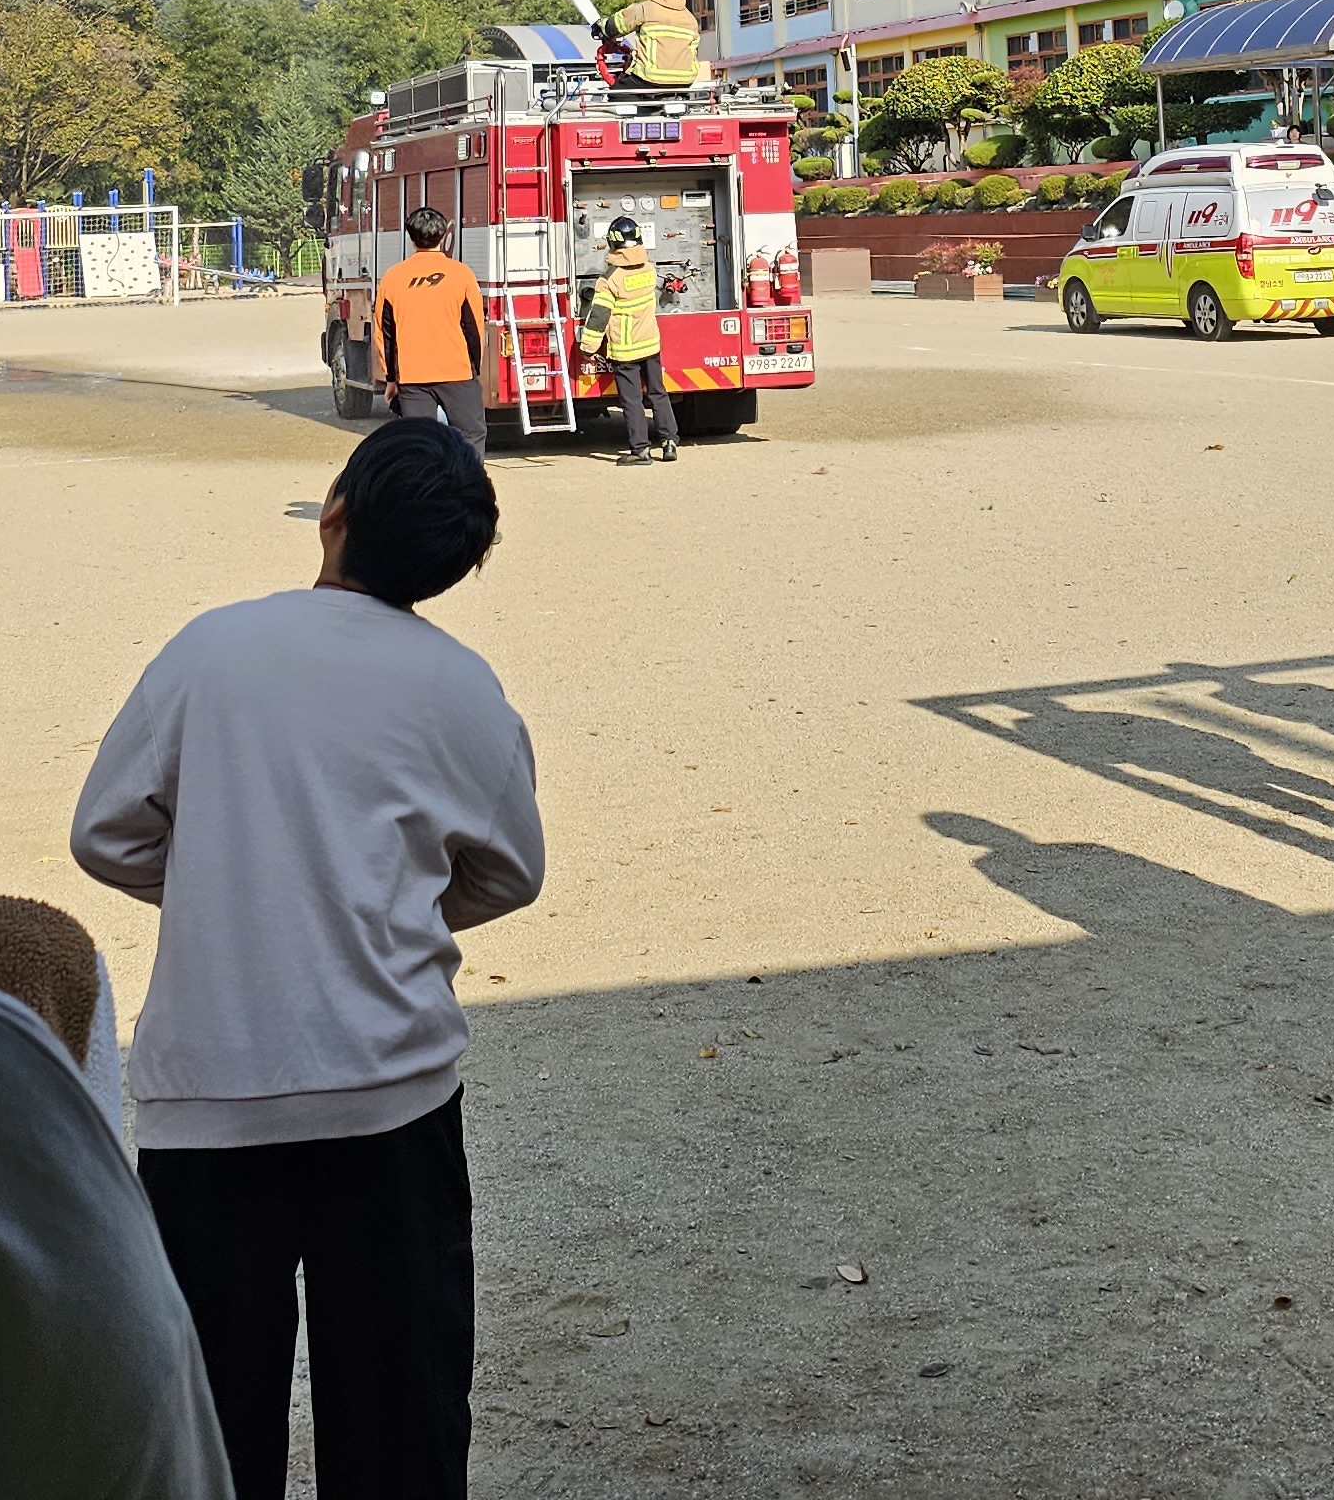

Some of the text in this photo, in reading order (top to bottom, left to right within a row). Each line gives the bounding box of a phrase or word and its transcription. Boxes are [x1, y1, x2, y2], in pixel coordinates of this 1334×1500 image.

[1186, 201, 1218, 227] 119
[1269, 199, 1319, 227] 119
[408, 272, 446, 288] 119
[748, 356, 808, 370] 998구 2247
